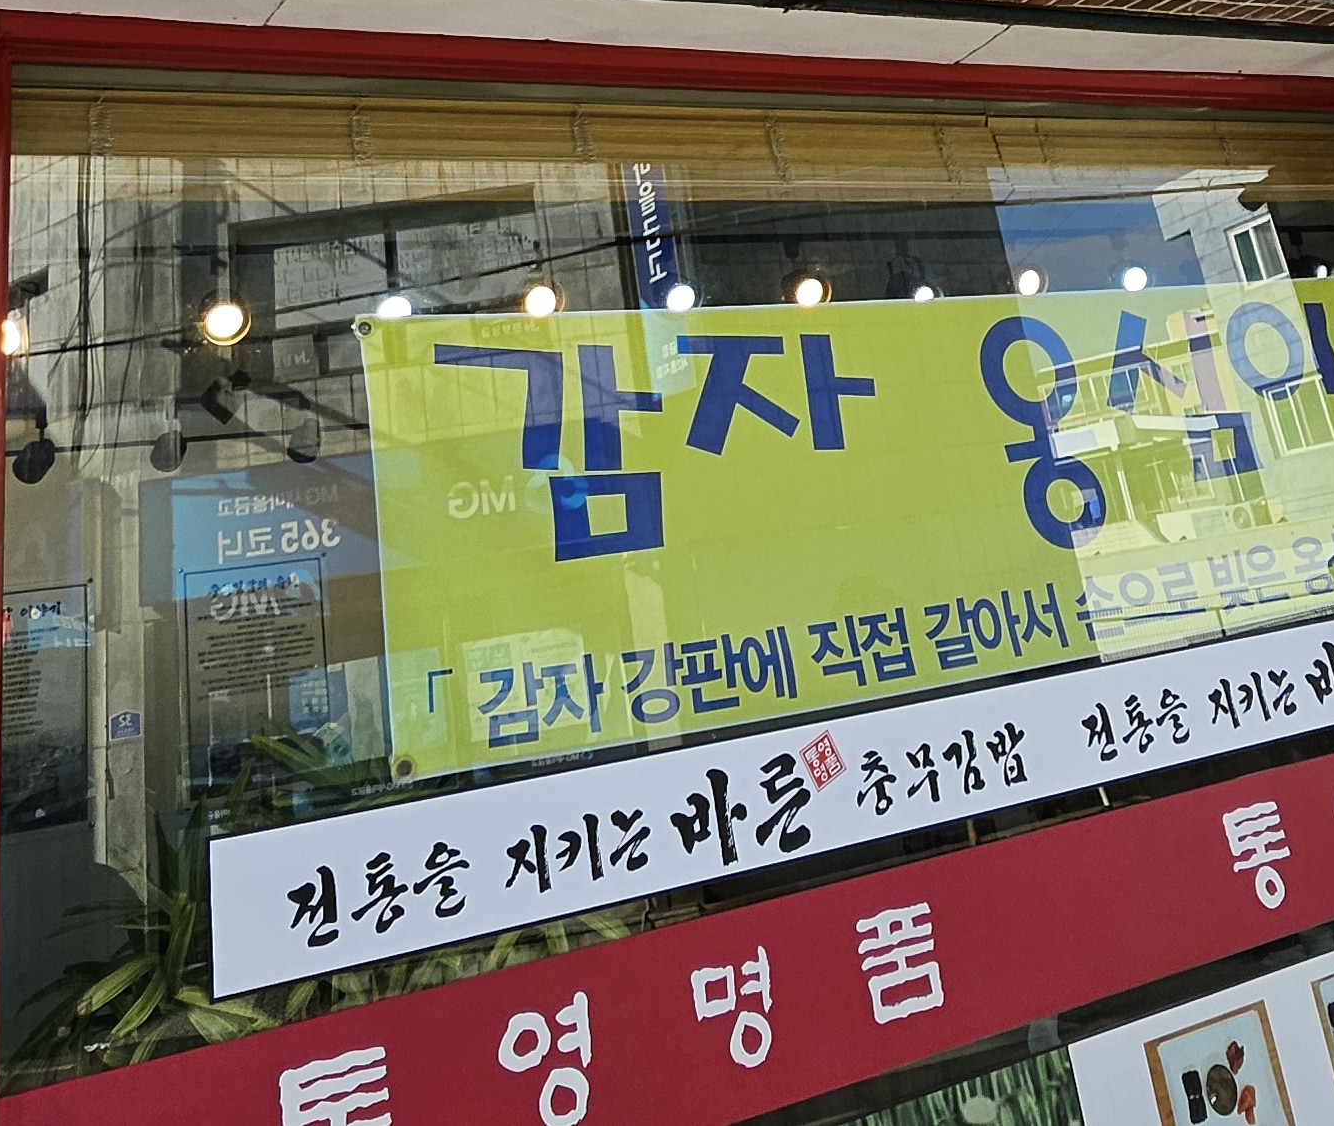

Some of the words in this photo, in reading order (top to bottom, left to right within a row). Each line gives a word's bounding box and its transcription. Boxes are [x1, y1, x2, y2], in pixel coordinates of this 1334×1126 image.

[434, 334, 875, 562] 감자
[478, 653, 604, 748] 감자
[621, 625, 798, 724] 강판에
[807, 607, 916, 687] 직접
[924, 582, 1069, 670] 갈아서
[1075, 562, 1207, 642] 손으로
[1081, 688, 1191, 761] 전통을
[1208, 669, 1297, 729] 지키는
[286, 841, 471, 949] 전통을
[505, 809, 652, 894] 지키는
[670, 753, 812, 867] 바른
[856, 724, 1026, 816] 충무김밥
